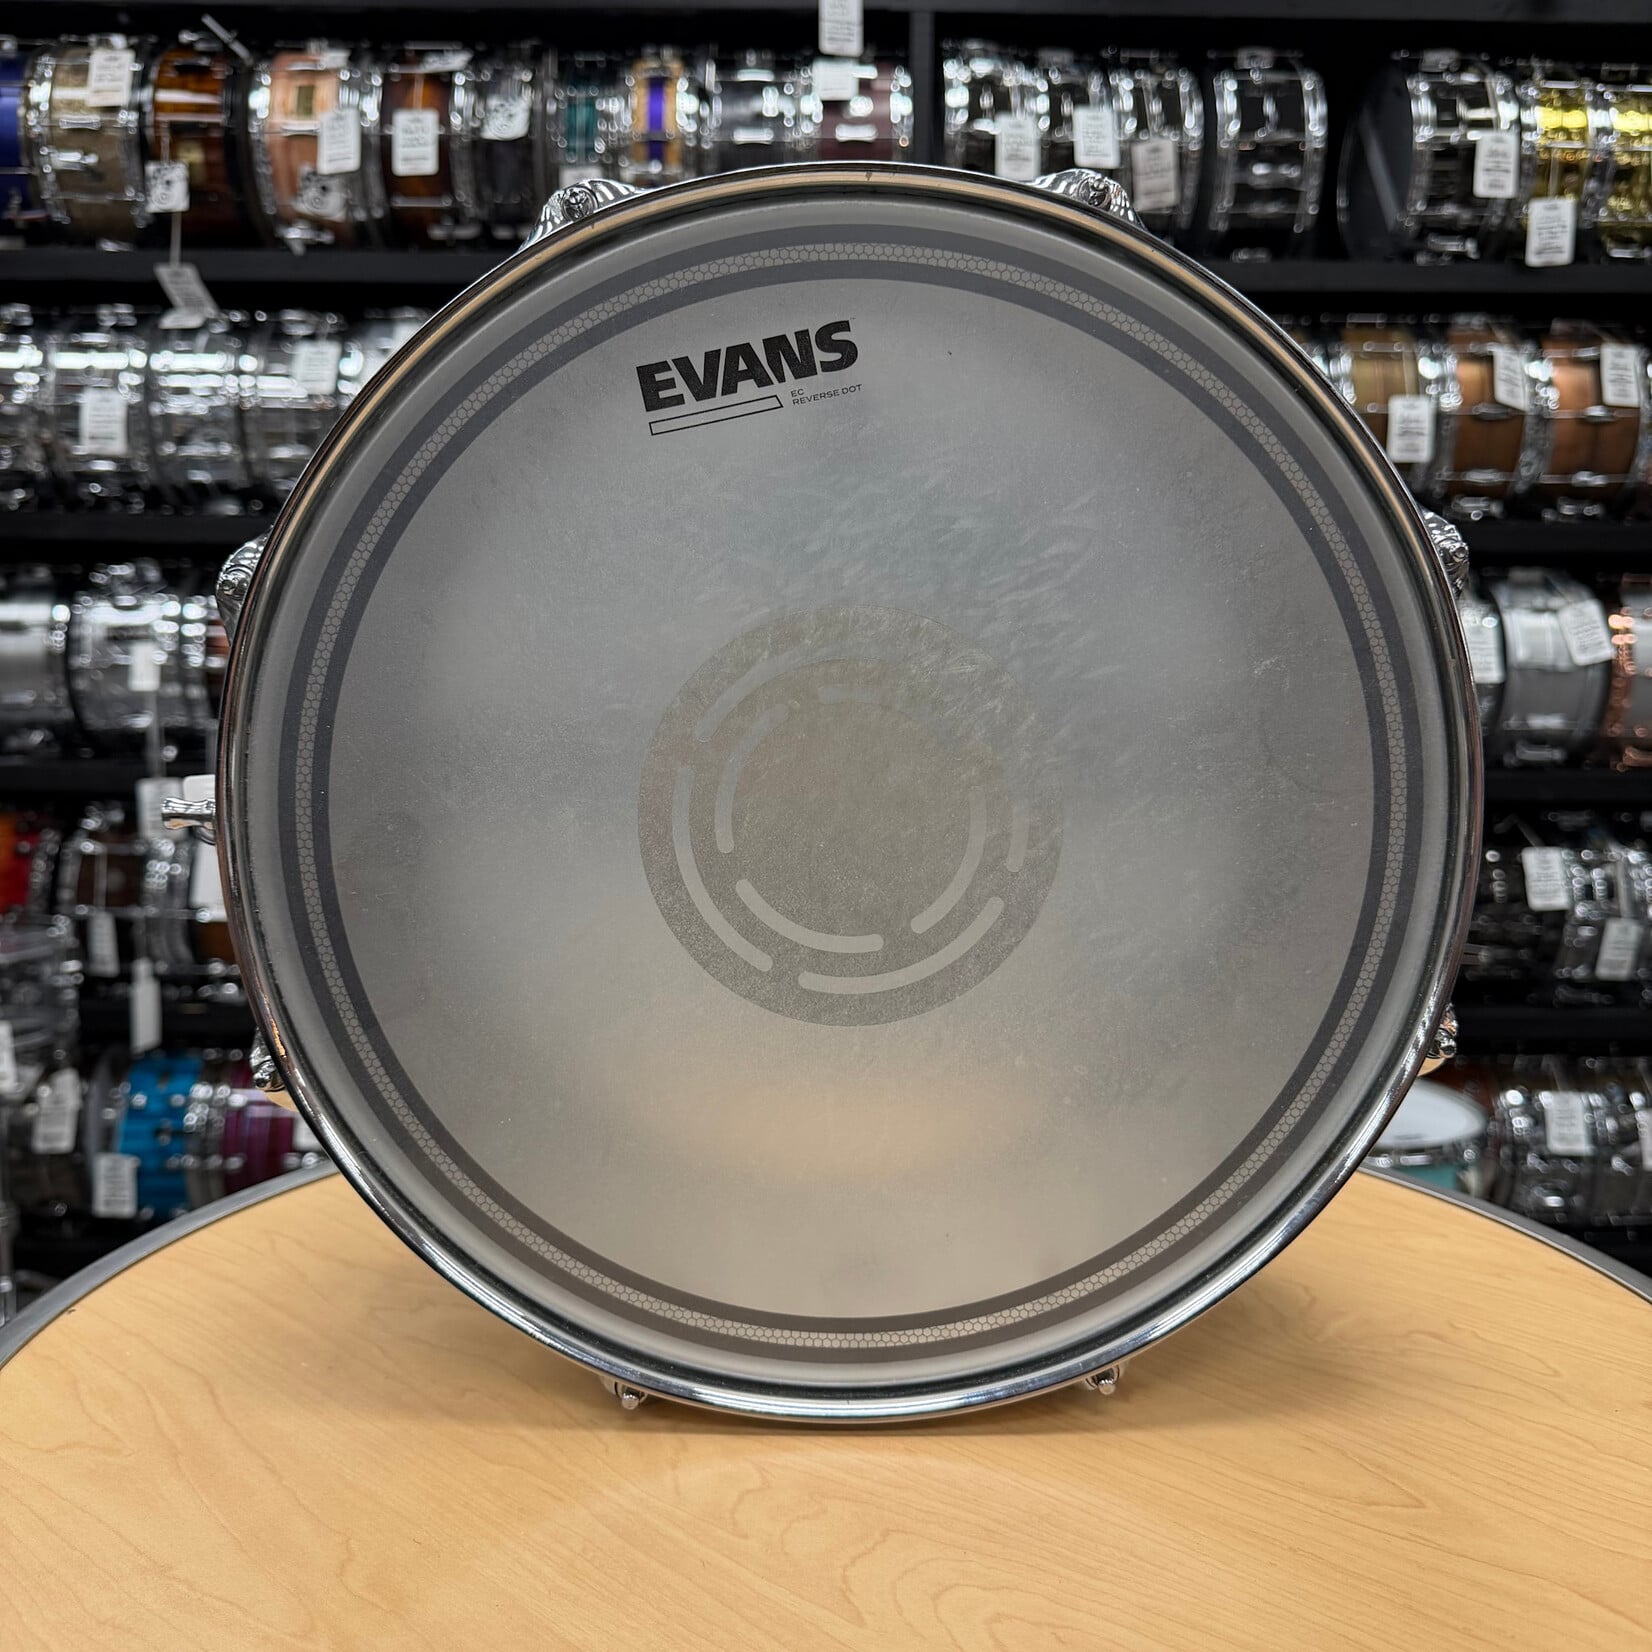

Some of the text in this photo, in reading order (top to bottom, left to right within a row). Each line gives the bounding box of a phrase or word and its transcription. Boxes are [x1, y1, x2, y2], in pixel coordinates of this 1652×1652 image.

[636, 320, 858, 412] EVANS
[790, 388, 804, 398] EC
[792, 384, 862, 406] REVERSE DOT
